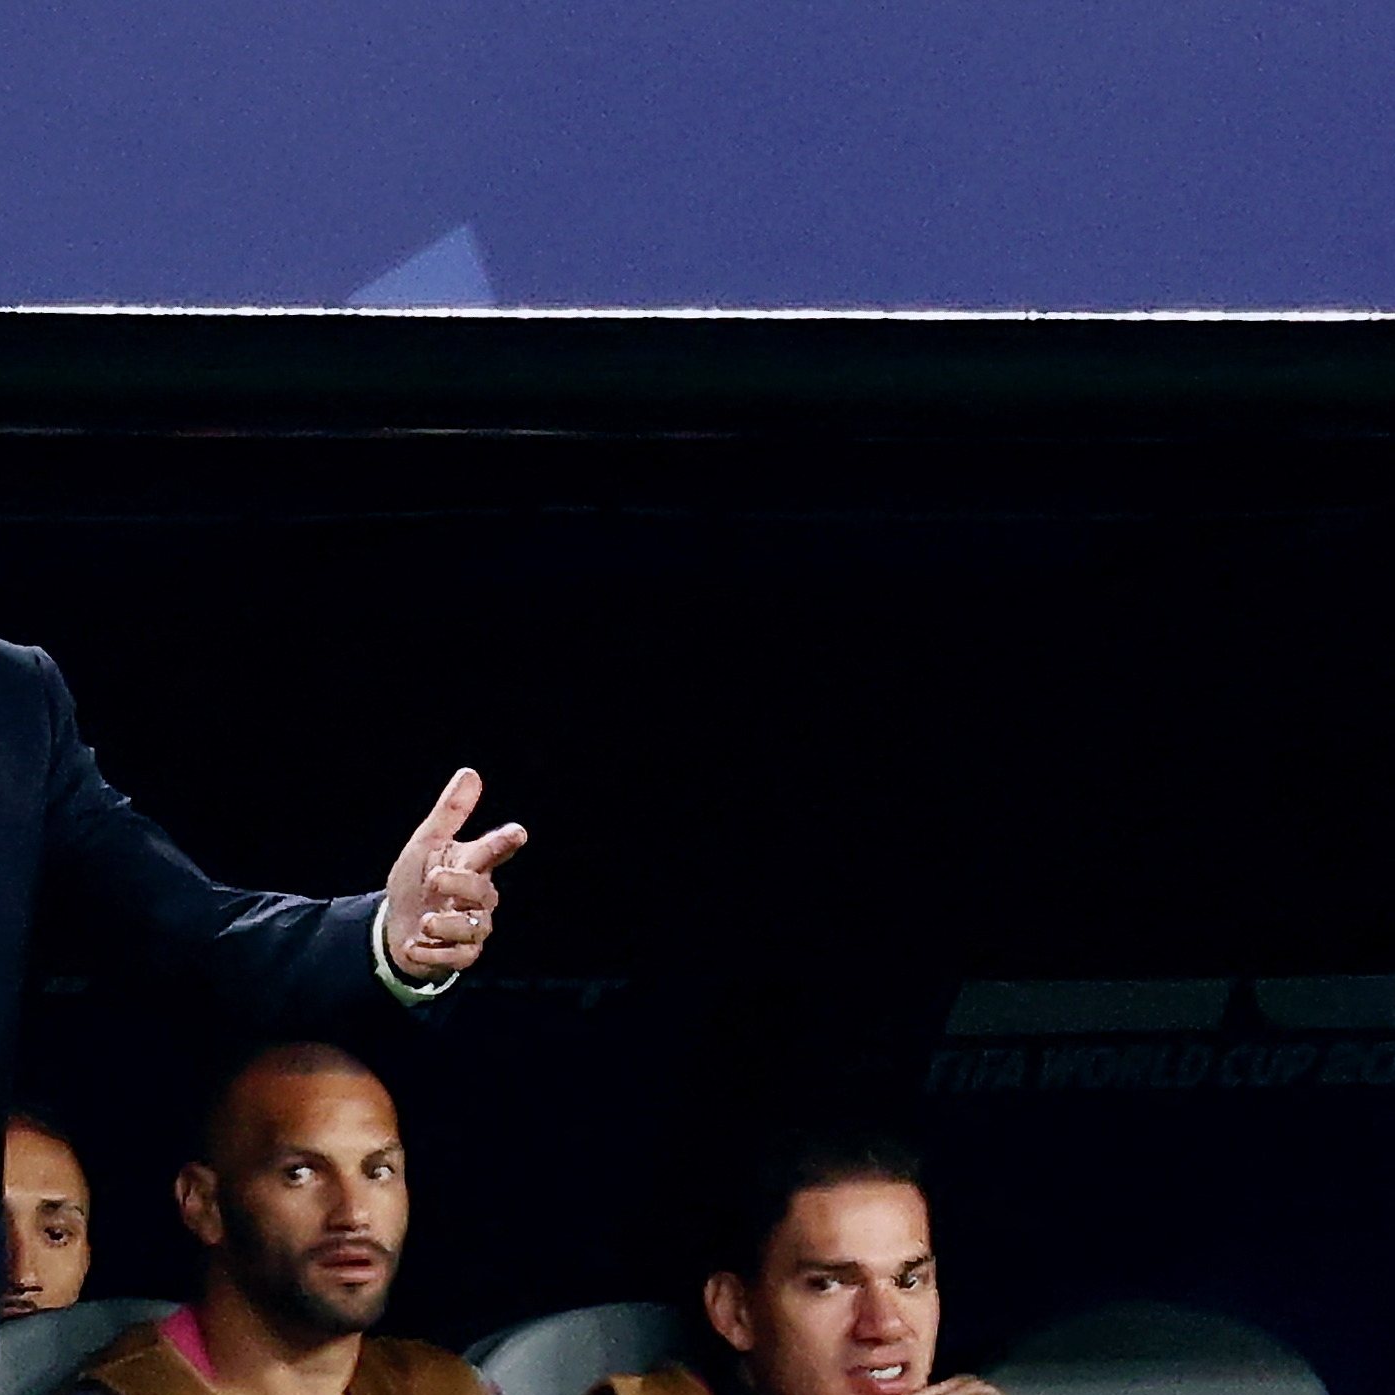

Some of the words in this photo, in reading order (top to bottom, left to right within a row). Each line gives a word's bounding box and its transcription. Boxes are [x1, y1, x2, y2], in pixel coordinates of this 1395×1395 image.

[924, 1048, 1026, 1093] FIFA
[1034, 1044, 1211, 1091] WORLD
[1219, 1042, 1318, 1089] CUP
